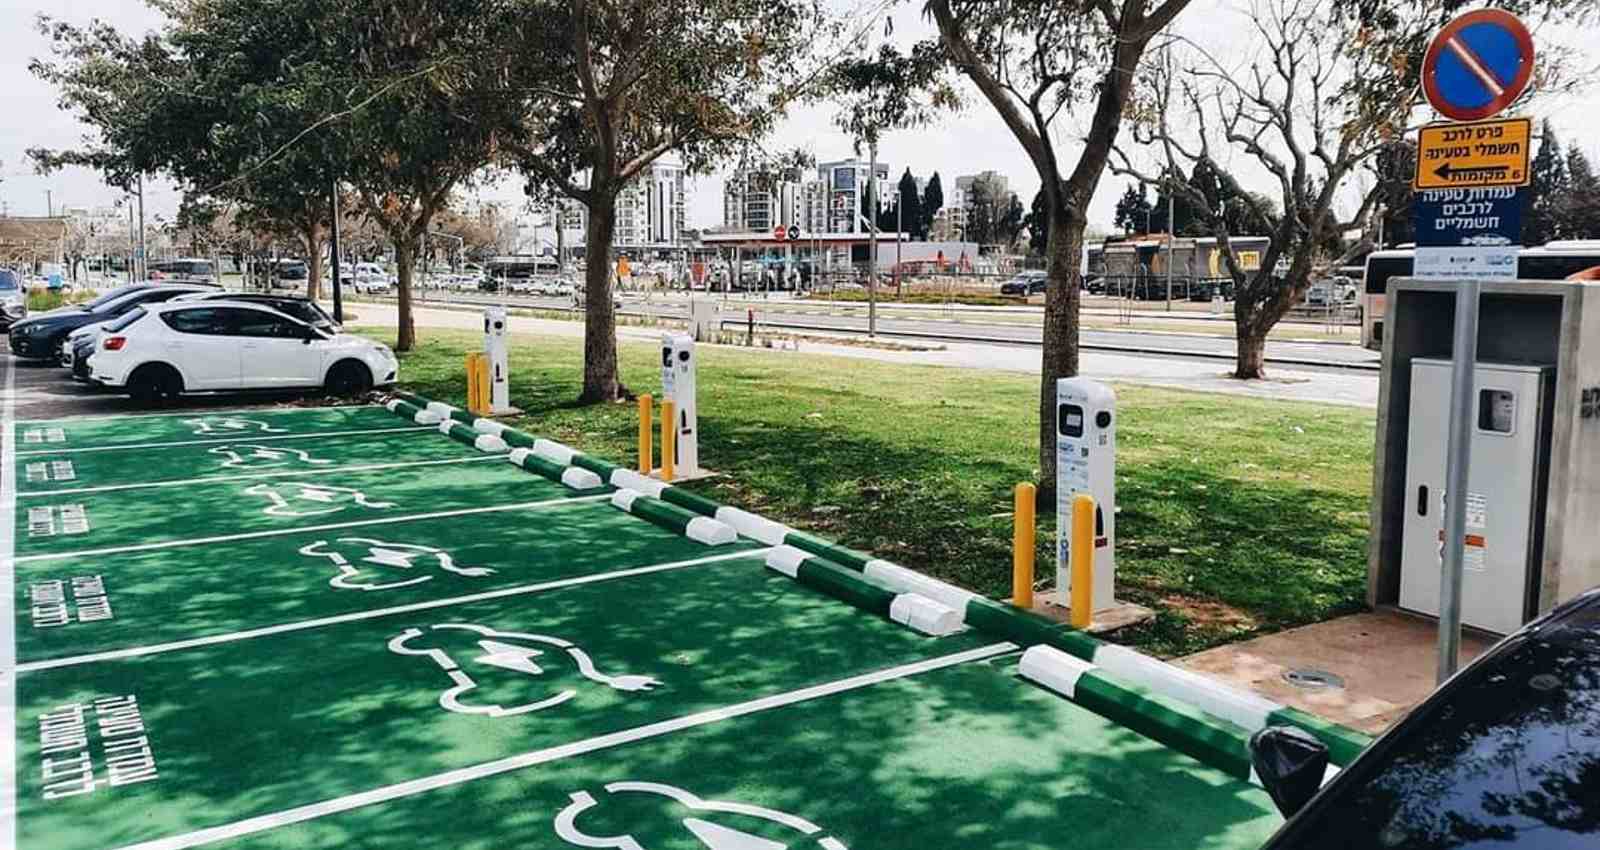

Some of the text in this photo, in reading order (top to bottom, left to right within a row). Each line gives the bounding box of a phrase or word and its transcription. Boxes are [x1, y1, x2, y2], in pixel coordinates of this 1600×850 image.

[1442, 126, 1504, 142] פרט לרכב
[1425, 142, 1520, 160] חשמלי בטעינה
[1450, 169, 1521, 185] 6 מקומות
[1423, 186, 1516, 203] עמדות טעינה
[1443, 200, 1494, 216] לרכבים
[1435, 216, 1501, 230] חשמליים
[94, 694, 160, 787] עמדת טעינה
[42, 750, 108, 800] לרכב
